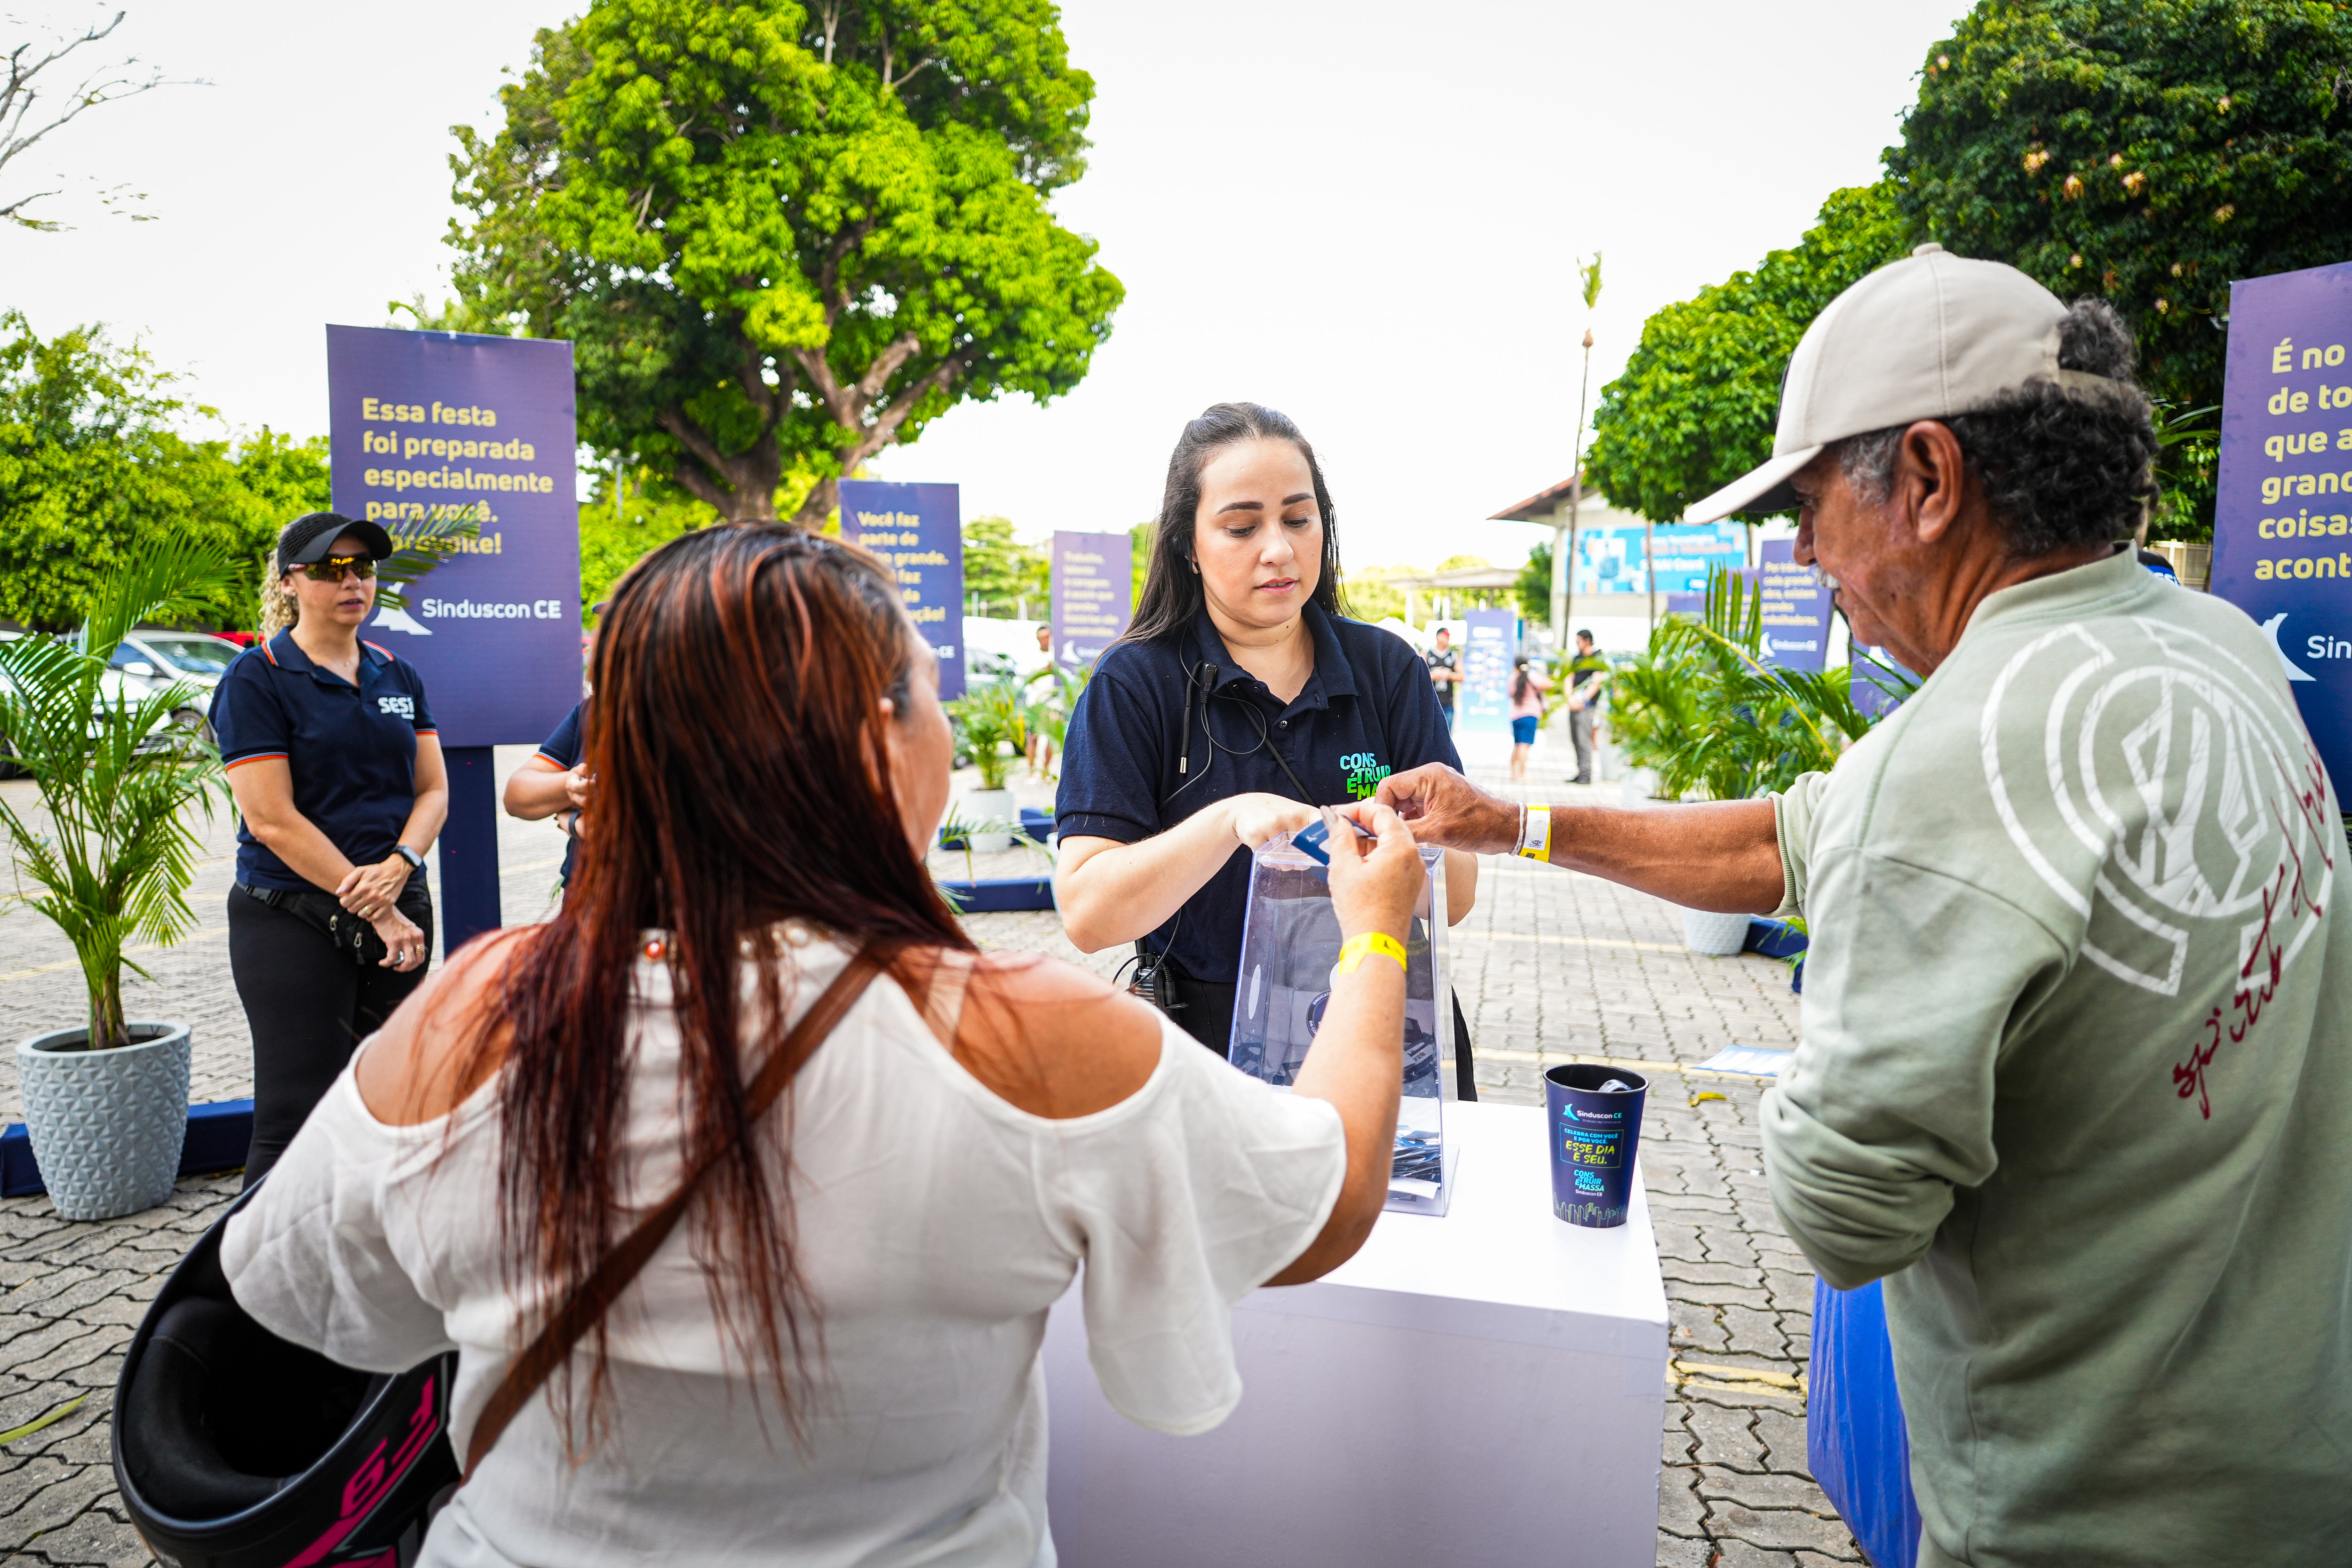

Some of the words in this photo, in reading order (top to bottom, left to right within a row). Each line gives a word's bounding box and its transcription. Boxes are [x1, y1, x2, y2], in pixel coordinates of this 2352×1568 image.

[2272, 337, 2293, 374] É
[2302, 344, 2345, 370] no
[2268, 387, 2309, 415] de
[363, 398, 425, 423] Essa
[432, 401, 496, 427] festa
[364, 430, 397, 454] foi
[405, 438, 535, 462] preparada
[2265, 431, 2328, 462] que
[365, 466, 554, 493] especialmente
[366, 501, 424, 522] para
[857, 511, 895, 527] Você
[896, 511, 920, 527] faz
[2258, 508, 2352, 539] coisa
[858, 532, 898, 546] parte
[899, 530, 919, 546] de
[894, 549, 949, 568] grande.
[898, 568, 922, 584] faz
[902, 588, 920, 603] da
[422, 598, 530, 618] Sinduscon
[534, 600, 562, 619] CE
[938, 645, 955, 659] CE
[1340, 752, 1376, 770] CONS
[1347, 772, 1357, 793] É
[1354, 764, 1391, 784] TRUIR
[1577, 1110, 1613, 1119] Sinduscon
[1564, 1128, 1589, 1137] CELEBRA
[1565, 1140, 1593, 1154] ESSE
[1596, 1145, 1615, 1155] DIA
[1573, 1151, 1581, 1162] É
[1583, 1154, 1607, 1164] SEU.
[1573, 1169, 1595, 1178] CONS
[1580, 1176, 1602, 1185] TRUIR
[1579, 1183, 1605, 1192] MASSA
